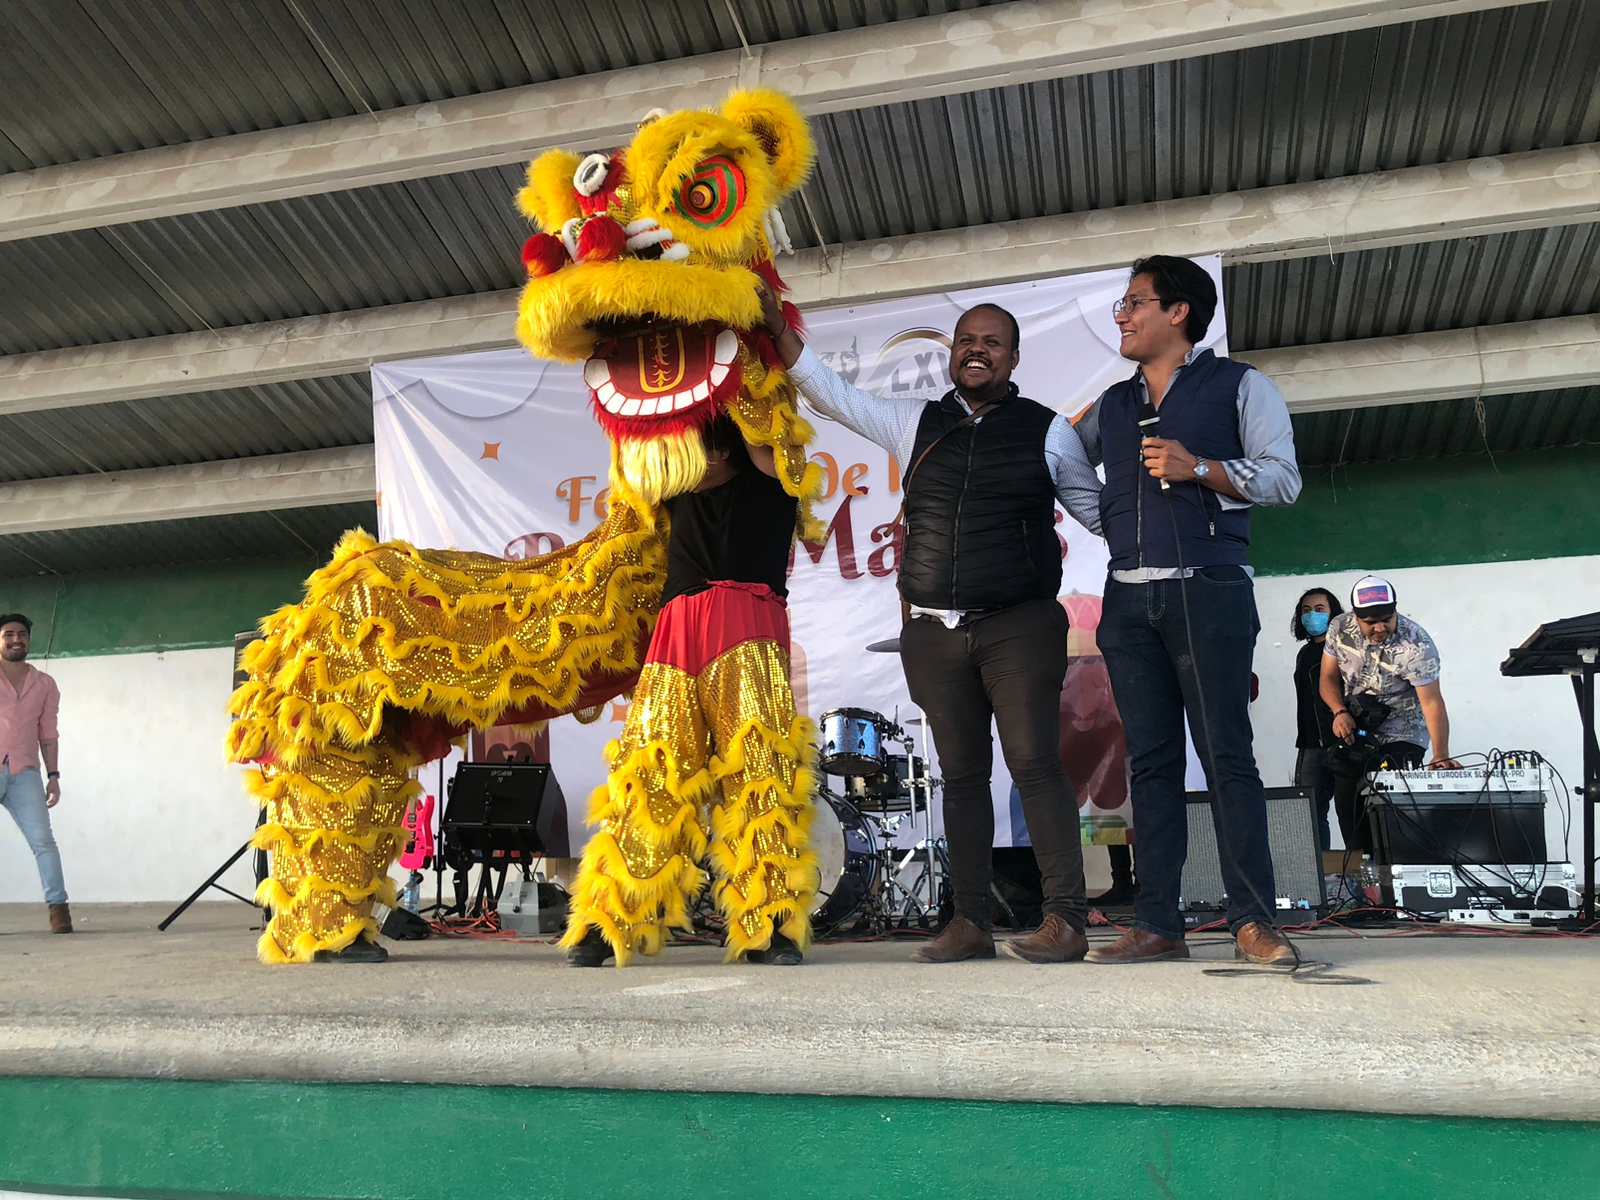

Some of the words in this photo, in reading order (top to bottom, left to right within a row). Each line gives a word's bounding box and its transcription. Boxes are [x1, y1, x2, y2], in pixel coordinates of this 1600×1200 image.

[891, 386, 952, 398] LEGISLATUR
[1437, 771, 1473, 779] EURODESK
[1474, 770, 1525, 778] SL242X-PRO
